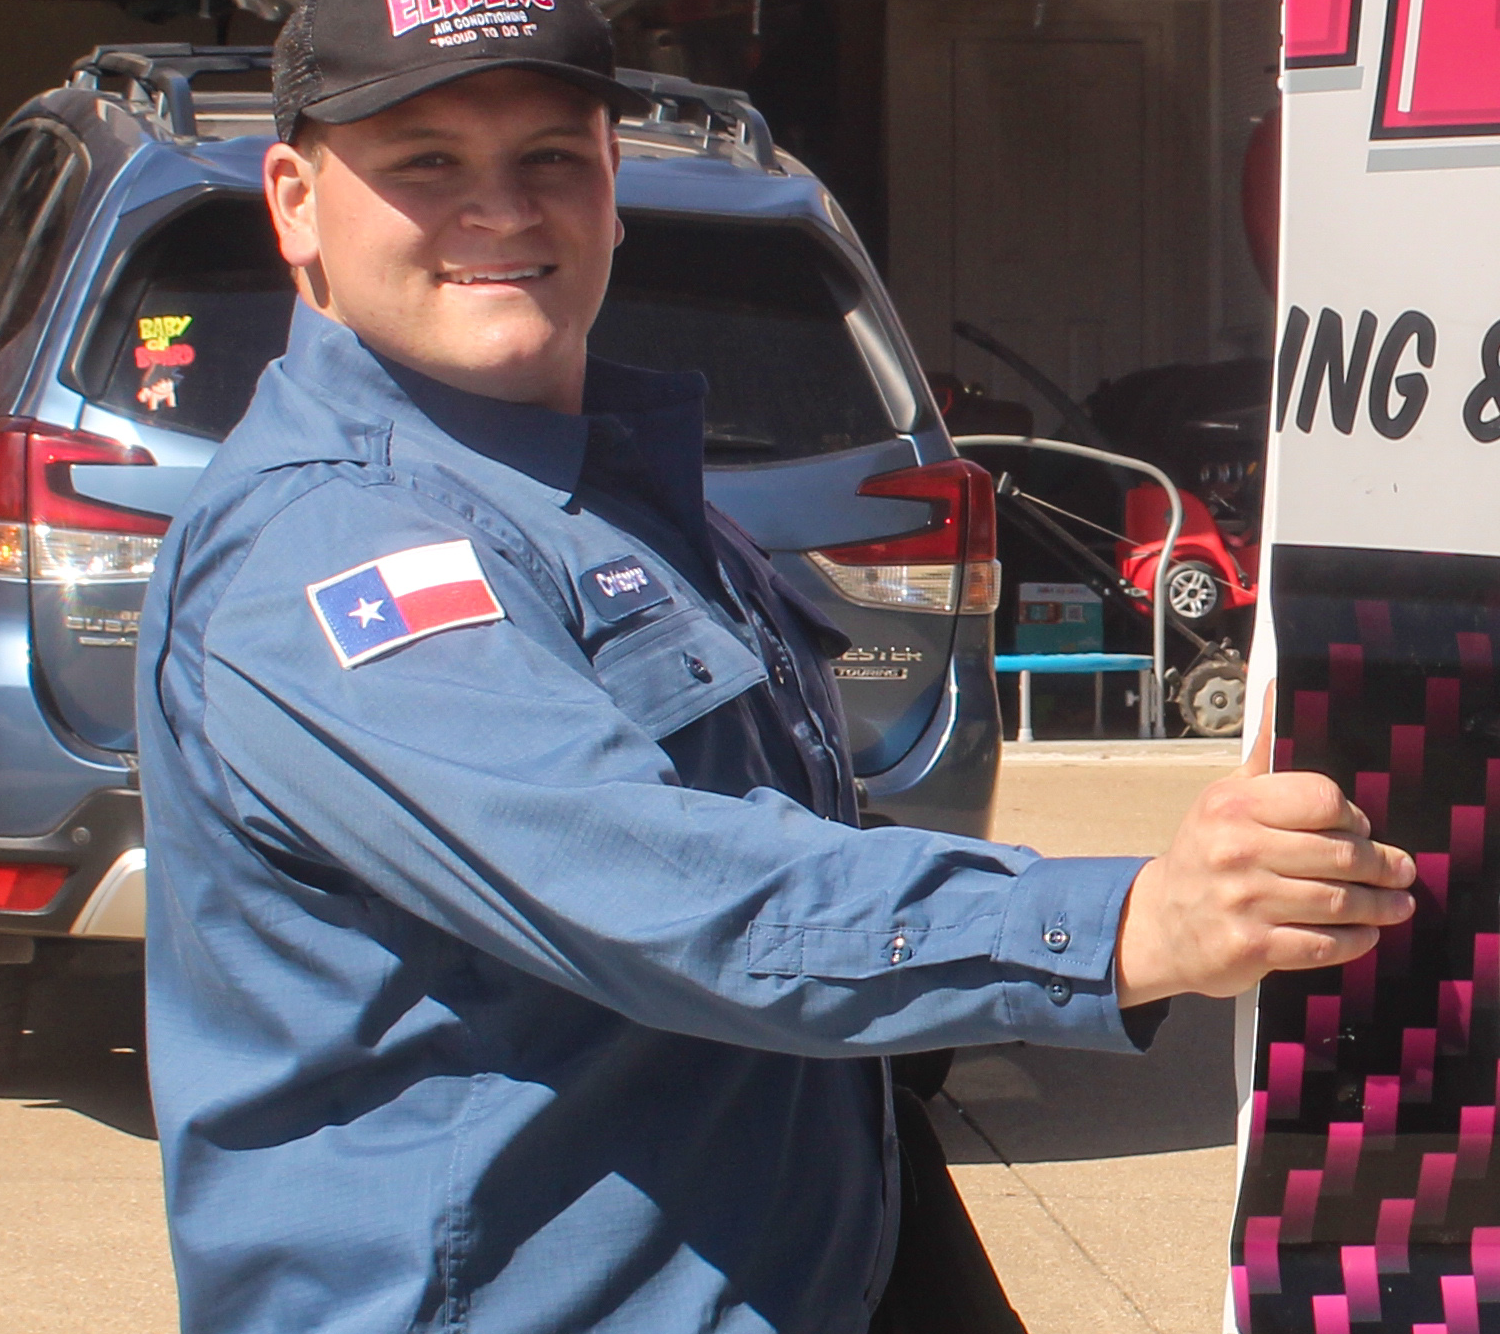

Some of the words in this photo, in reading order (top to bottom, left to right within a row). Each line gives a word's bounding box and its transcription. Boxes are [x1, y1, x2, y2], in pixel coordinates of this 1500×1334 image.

[433, 20, 454, 36] AIR
[454, 10, 529, 30] CONDITIONING
[429, 30, 478, 48] "PROUD
[482, 26, 498, 39] TO
[502, 24, 519, 38] DO
[138, 315, 192, 340] BABY
[838, 647, 923, 662] ESTER
